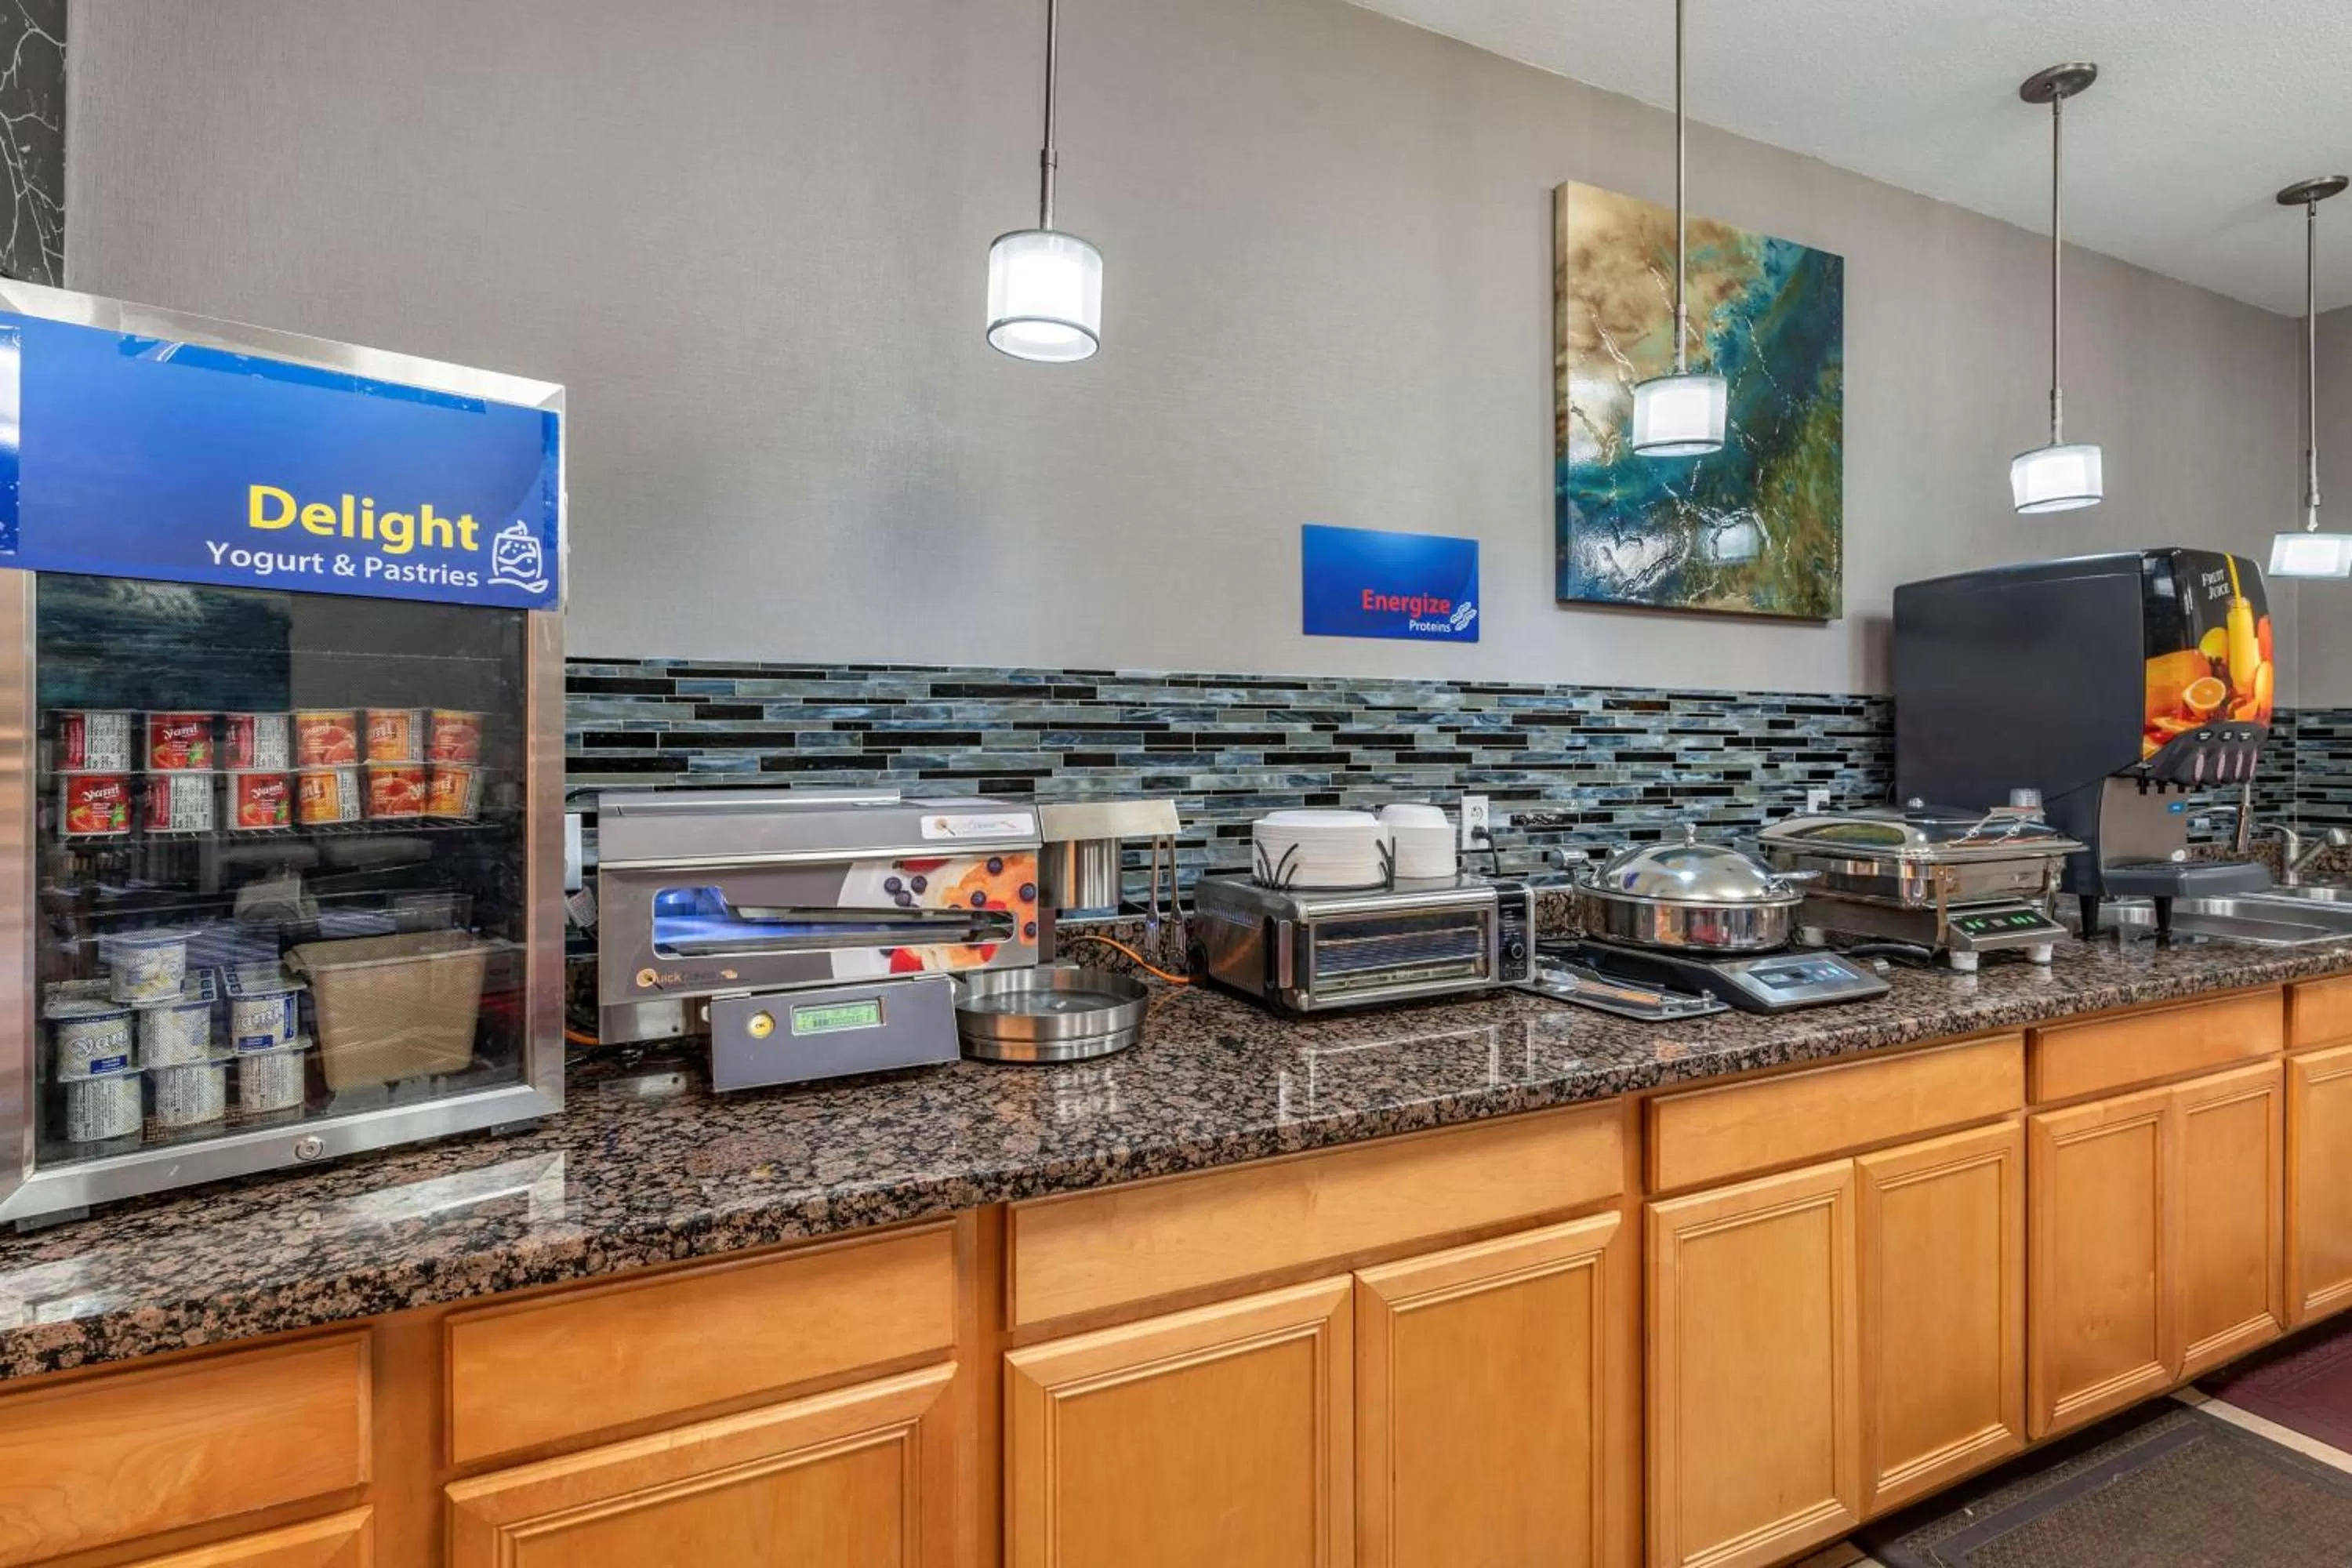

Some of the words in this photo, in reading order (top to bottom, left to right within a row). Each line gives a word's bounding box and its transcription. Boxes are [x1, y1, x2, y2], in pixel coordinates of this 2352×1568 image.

[249, 484, 479, 554] Delight
[206, 540, 324, 575] Yogurt
[332, 554, 357, 577] &
[364, 557, 479, 587] Pastries
[1361, 589, 1451, 619] Energize
[1409, 619, 1451, 633] Proteins
